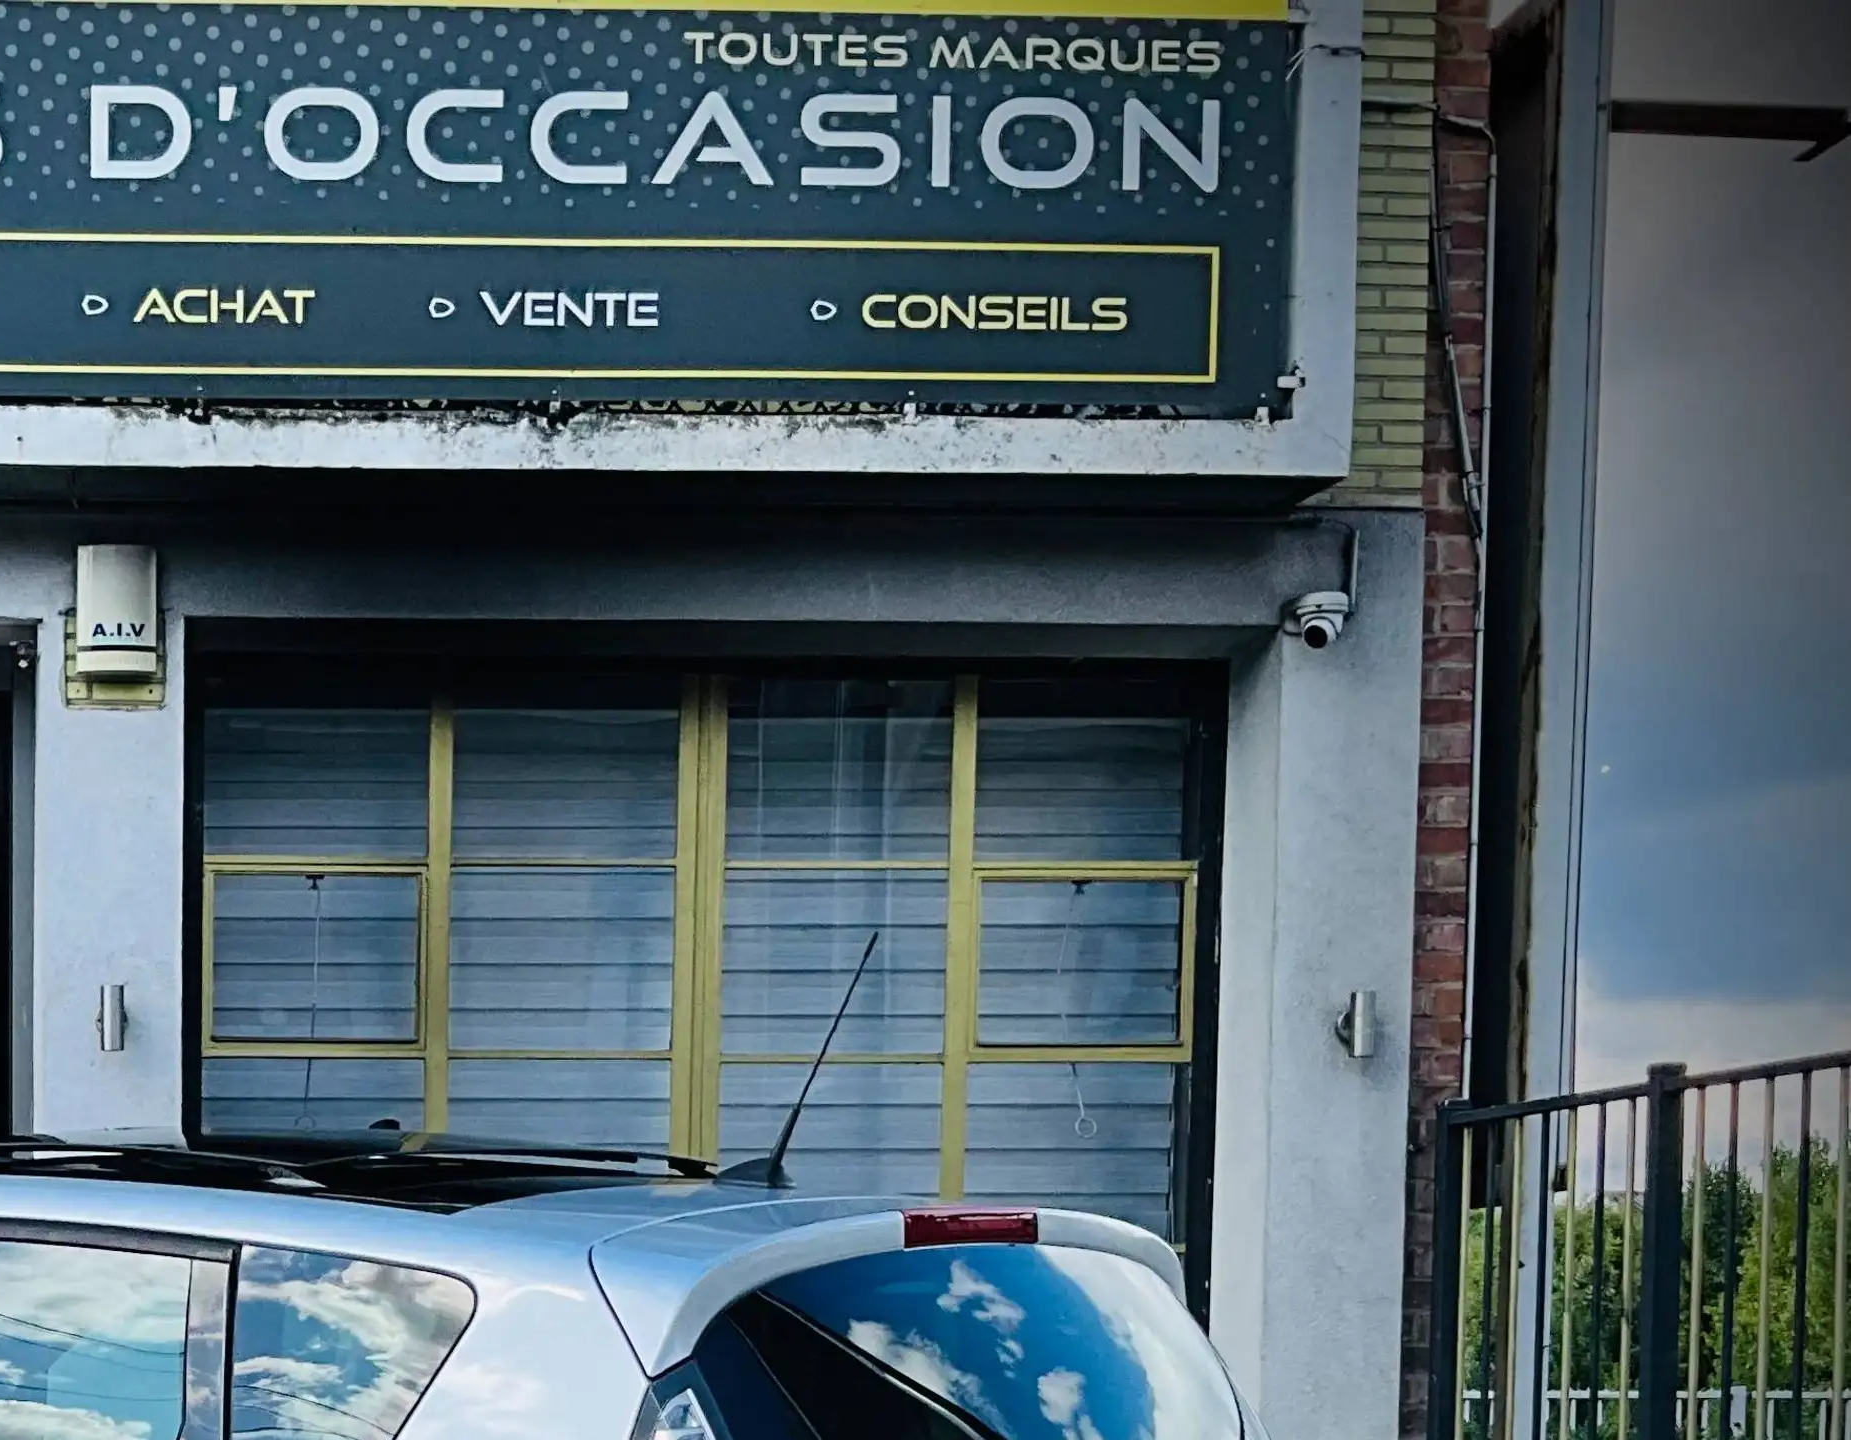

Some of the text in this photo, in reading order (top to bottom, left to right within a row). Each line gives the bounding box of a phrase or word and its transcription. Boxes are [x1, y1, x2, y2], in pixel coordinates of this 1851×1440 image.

[682, 30, 1223, 75] TOUTES MARQUES
[88, 83, 1223, 194] D'OCCASION
[132, 287, 317, 326] ACHAT
[478, 290, 662, 330] VENTE
[860, 292, 1129, 333] CONSEILS
[92, 622, 146, 638] A.I.V
